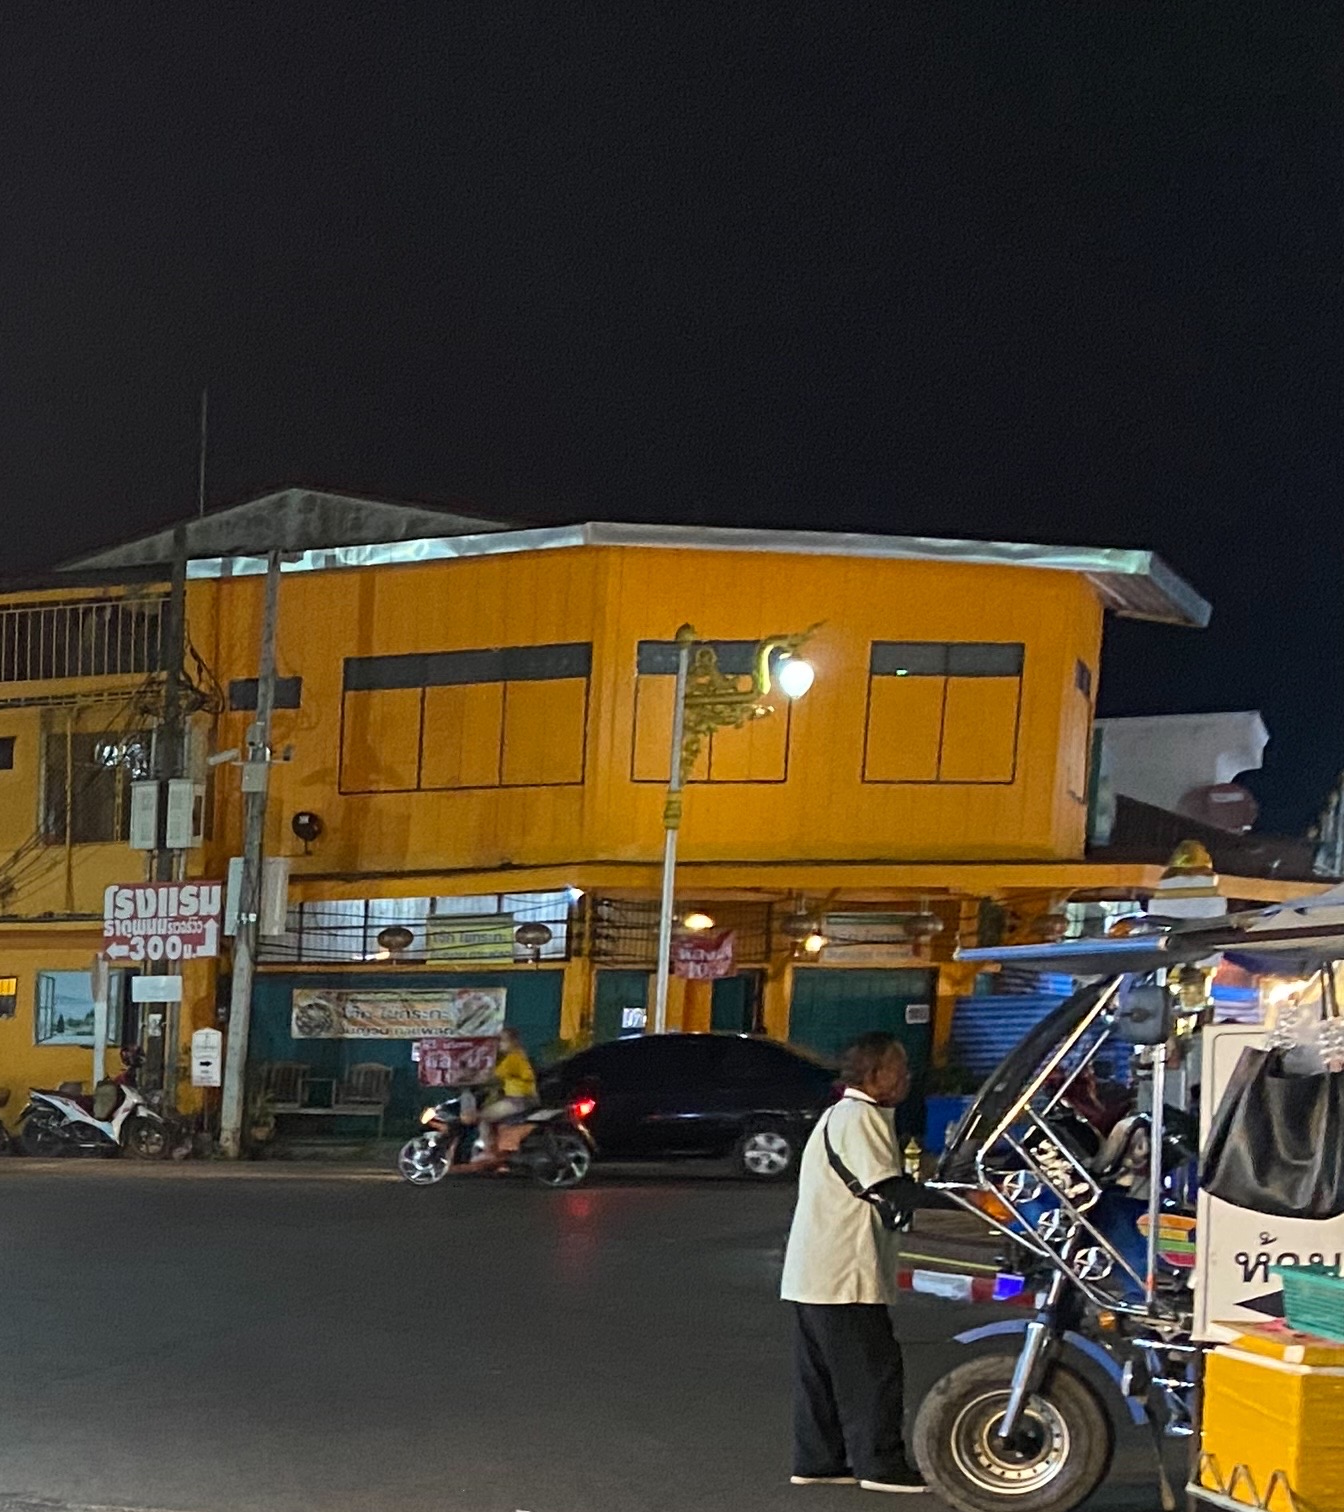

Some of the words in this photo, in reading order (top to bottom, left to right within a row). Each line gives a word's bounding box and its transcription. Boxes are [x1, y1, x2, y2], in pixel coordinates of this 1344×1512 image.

[103, 885, 222, 919] โรงแรม
[129, 935, 182, 960] 300
